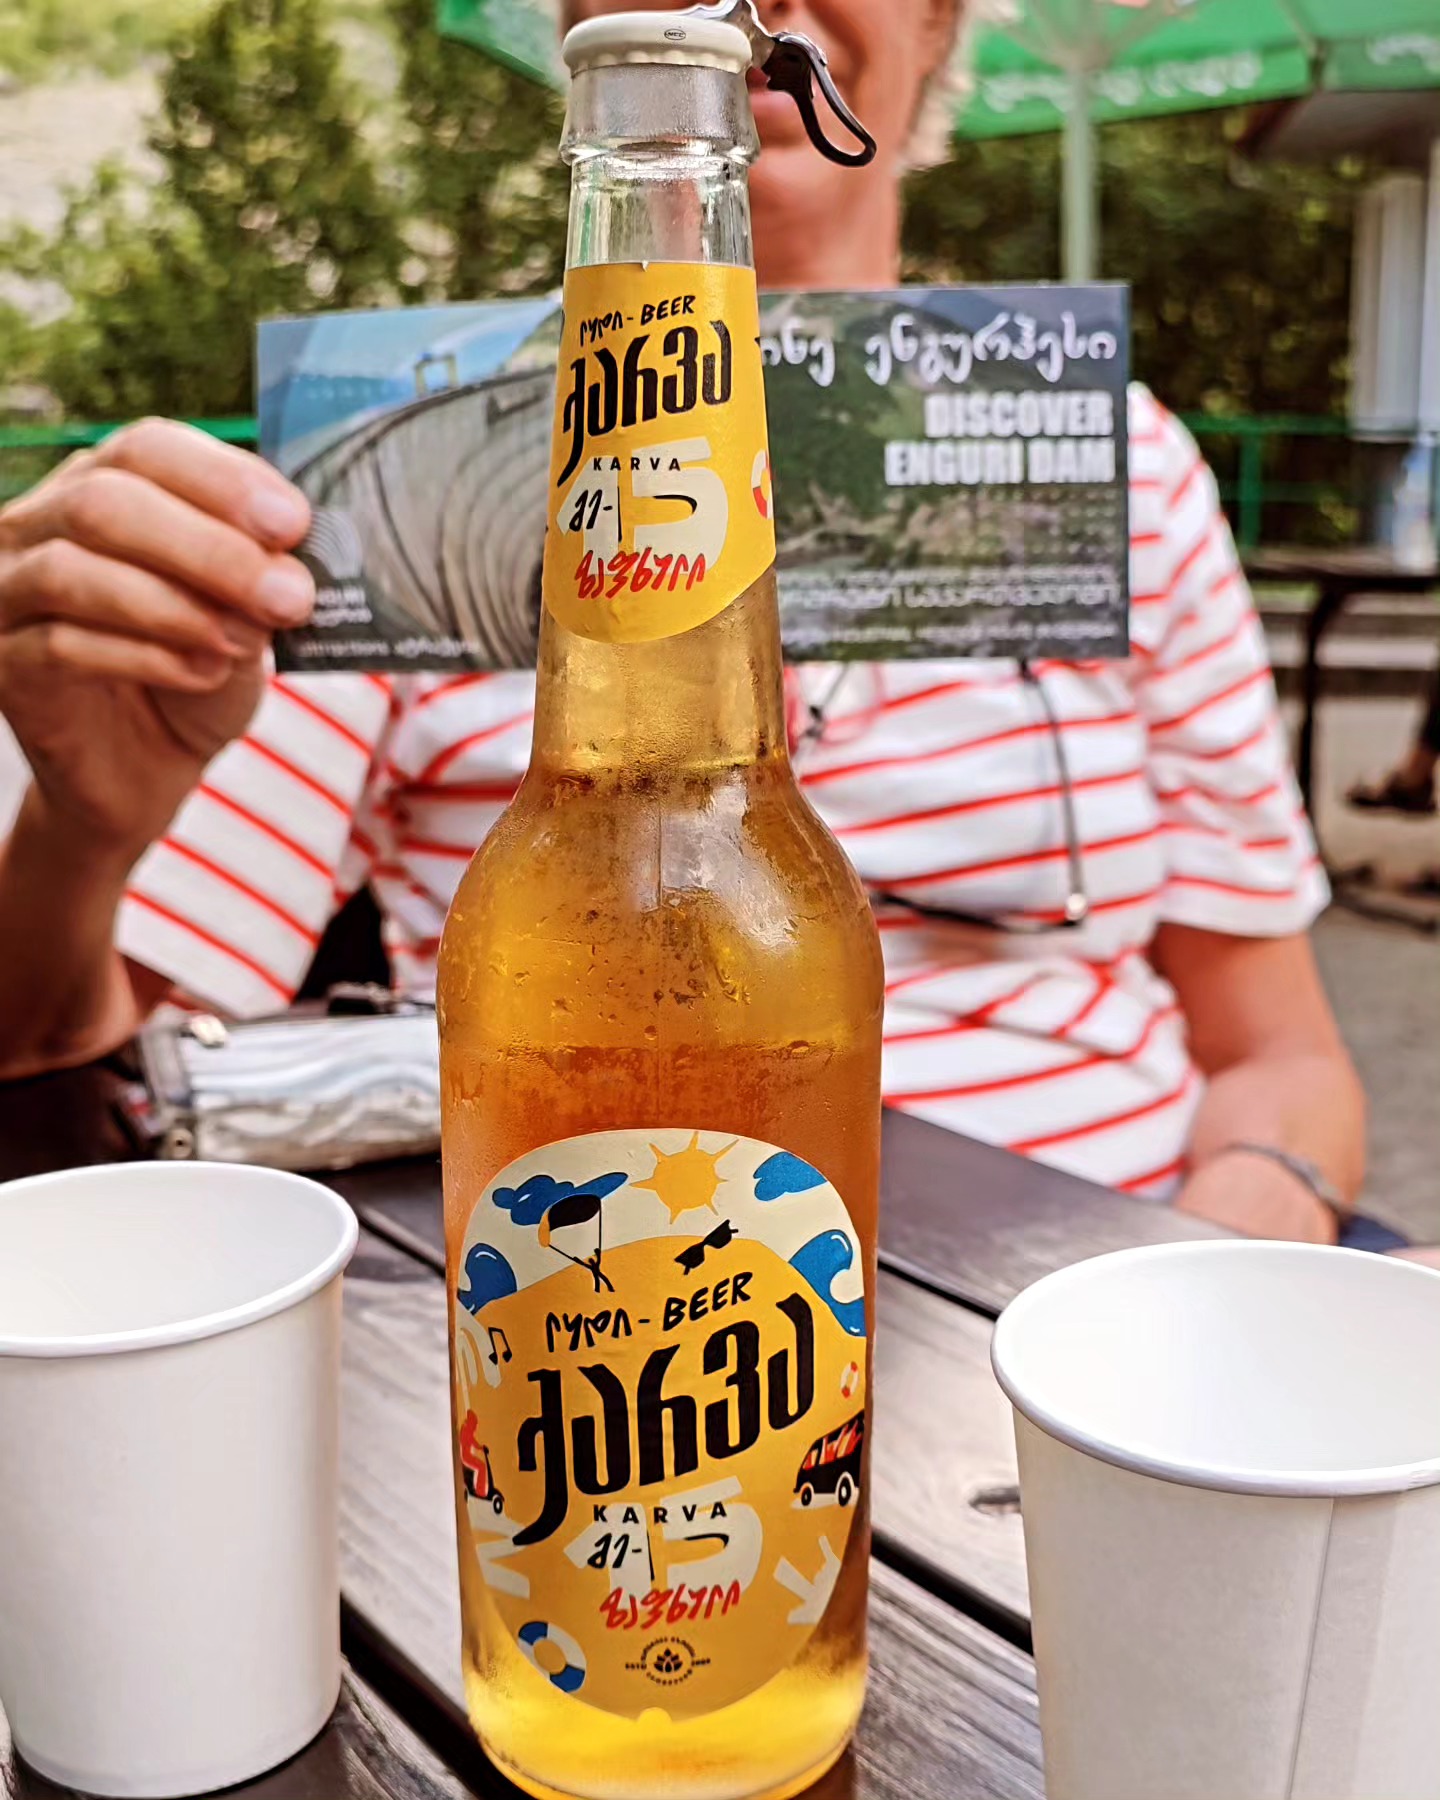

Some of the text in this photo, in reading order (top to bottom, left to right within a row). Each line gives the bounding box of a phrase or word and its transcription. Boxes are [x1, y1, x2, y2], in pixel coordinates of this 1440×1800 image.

[641, 295, 696, 326] BEER
[557, 320, 732, 488] ქარვა
[925, 391, 1114, 438] DISCOVER
[593, 457, 681, 472] KARVA
[884, 438, 1116, 486] ENGURI DAM
[662, 1272, 753, 1332] BEER
[512, 1293, 815, 1547] ქარვა
[593, 1501, 728, 1525] KARVA
